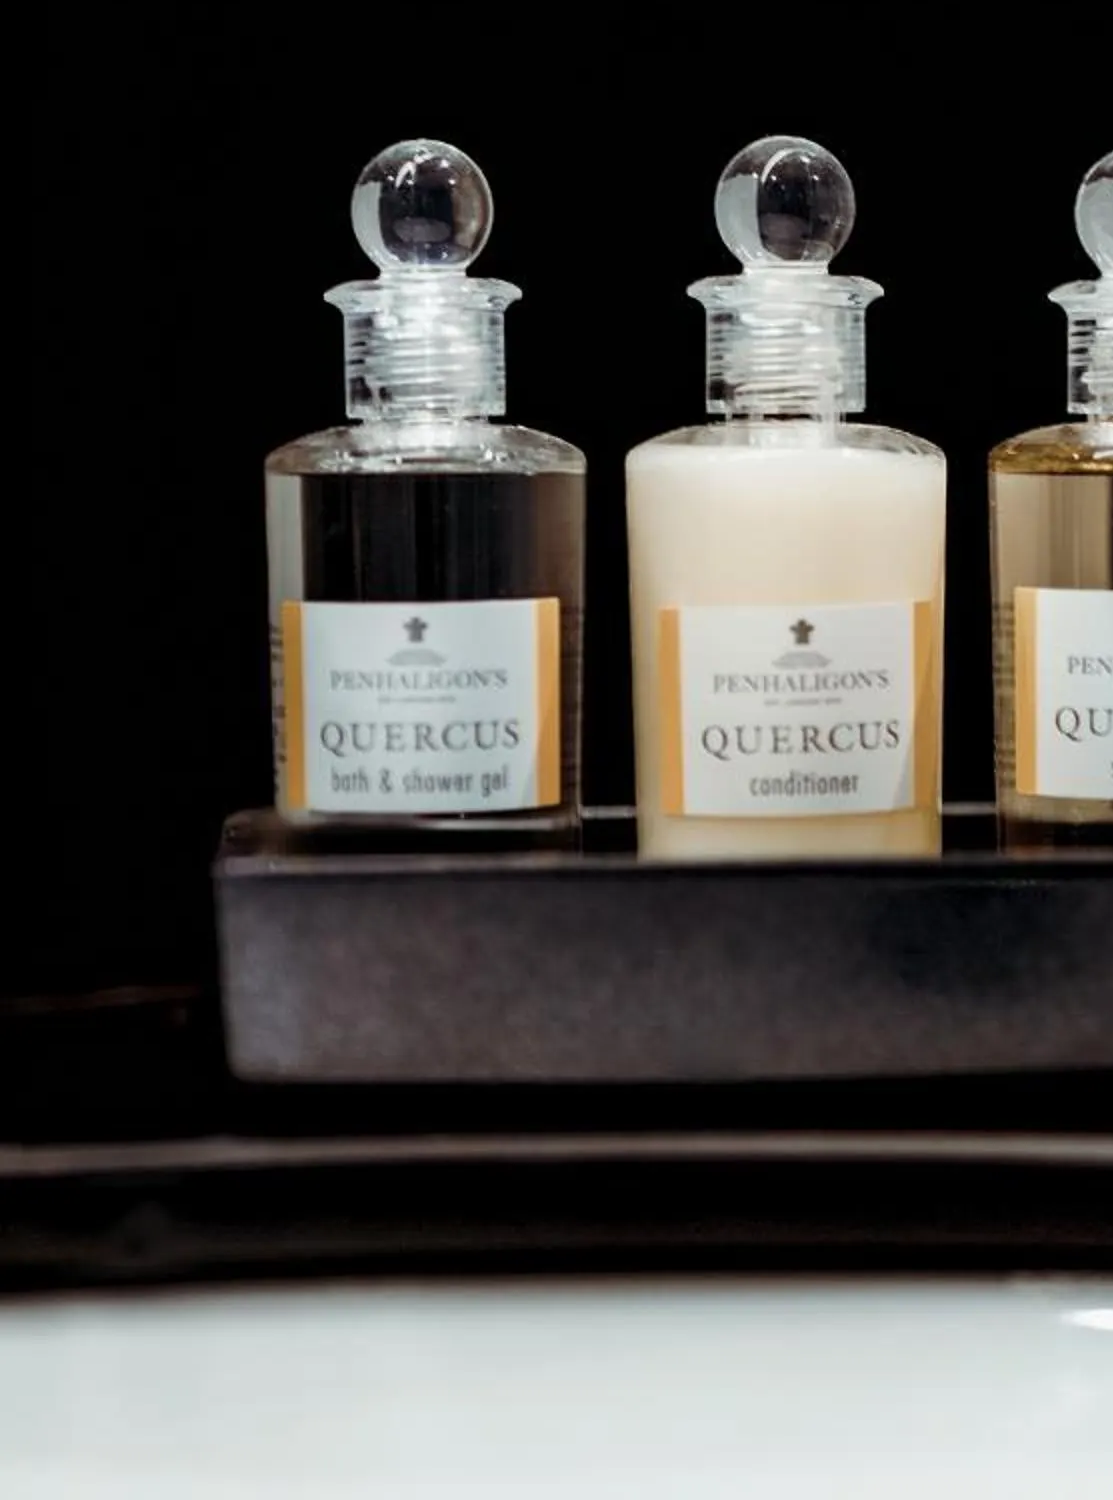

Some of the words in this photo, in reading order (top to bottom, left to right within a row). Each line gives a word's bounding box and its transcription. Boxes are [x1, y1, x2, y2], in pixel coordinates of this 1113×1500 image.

[712, 669, 890, 694] PENHALIGON'S
[319, 718, 521, 757] QUERCUS
[701, 719, 900, 761] QUERCUS
[330, 766, 369, 793] bath
[378, 768, 393, 794] &
[402, 767, 473, 793] shower
[480, 763, 508, 798] gel
[749, 768, 859, 797] conditioner
